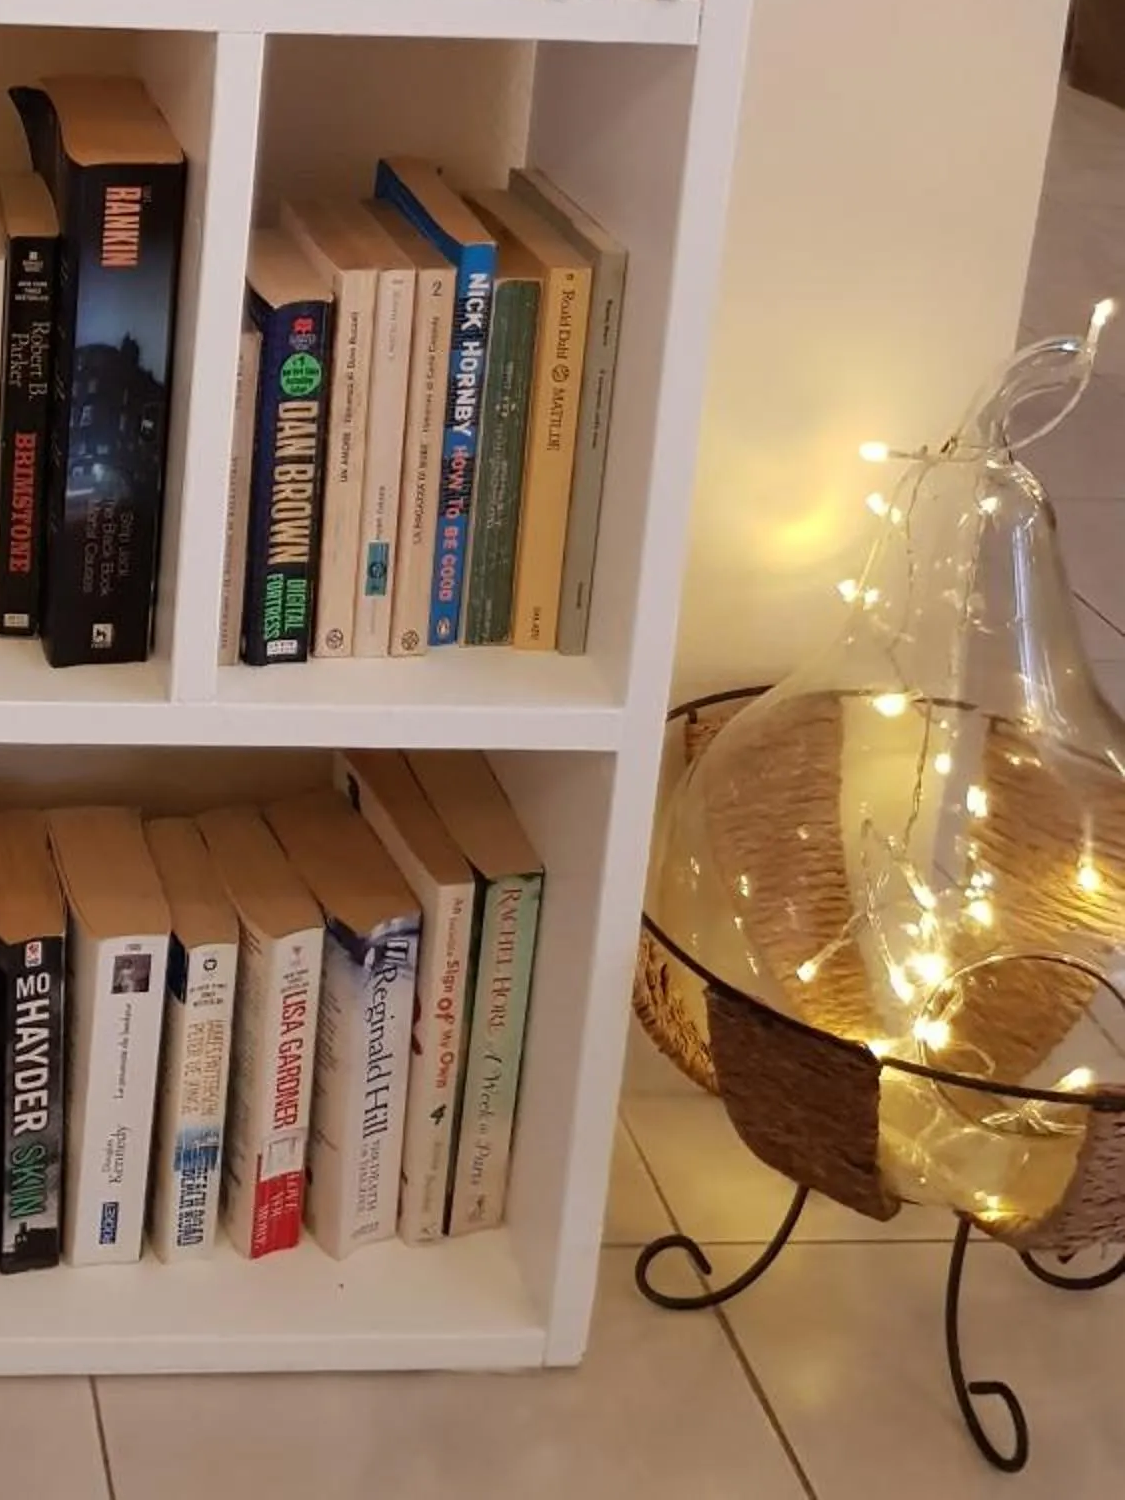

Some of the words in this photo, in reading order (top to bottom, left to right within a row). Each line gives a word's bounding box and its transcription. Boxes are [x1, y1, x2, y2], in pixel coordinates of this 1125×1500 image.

[101, 185, 143, 268] RANKIN
[463, 272, 490, 331] NICK
[8, 332, 30, 390] Parker
[28, 321, 51, 379] Robert
[26, 382, 47, 401] B.
[452, 339, 481, 437] HORNBY
[278, 399, 318, 459] DAN
[448, 444, 470, 491] HOW
[9, 432, 37, 573] BRIMSTONE
[270, 462, 315, 565] BROWN
[445, 497, 465, 520] TO
[443, 525, 460, 550] BE
[263, 571, 285, 639] FORTRESS
[283, 578, 308, 632] DIGITAL
[438, 553, 458, 601] GOOD
[16, 972, 51, 995] MO
[280, 989, 308, 1037] LISA
[364, 965, 400, 1084] Reginald
[13, 998, 51, 1137] HAYDER
[272, 1038, 304, 1130] GARDNER
[361, 1084, 391, 1139] Hill
